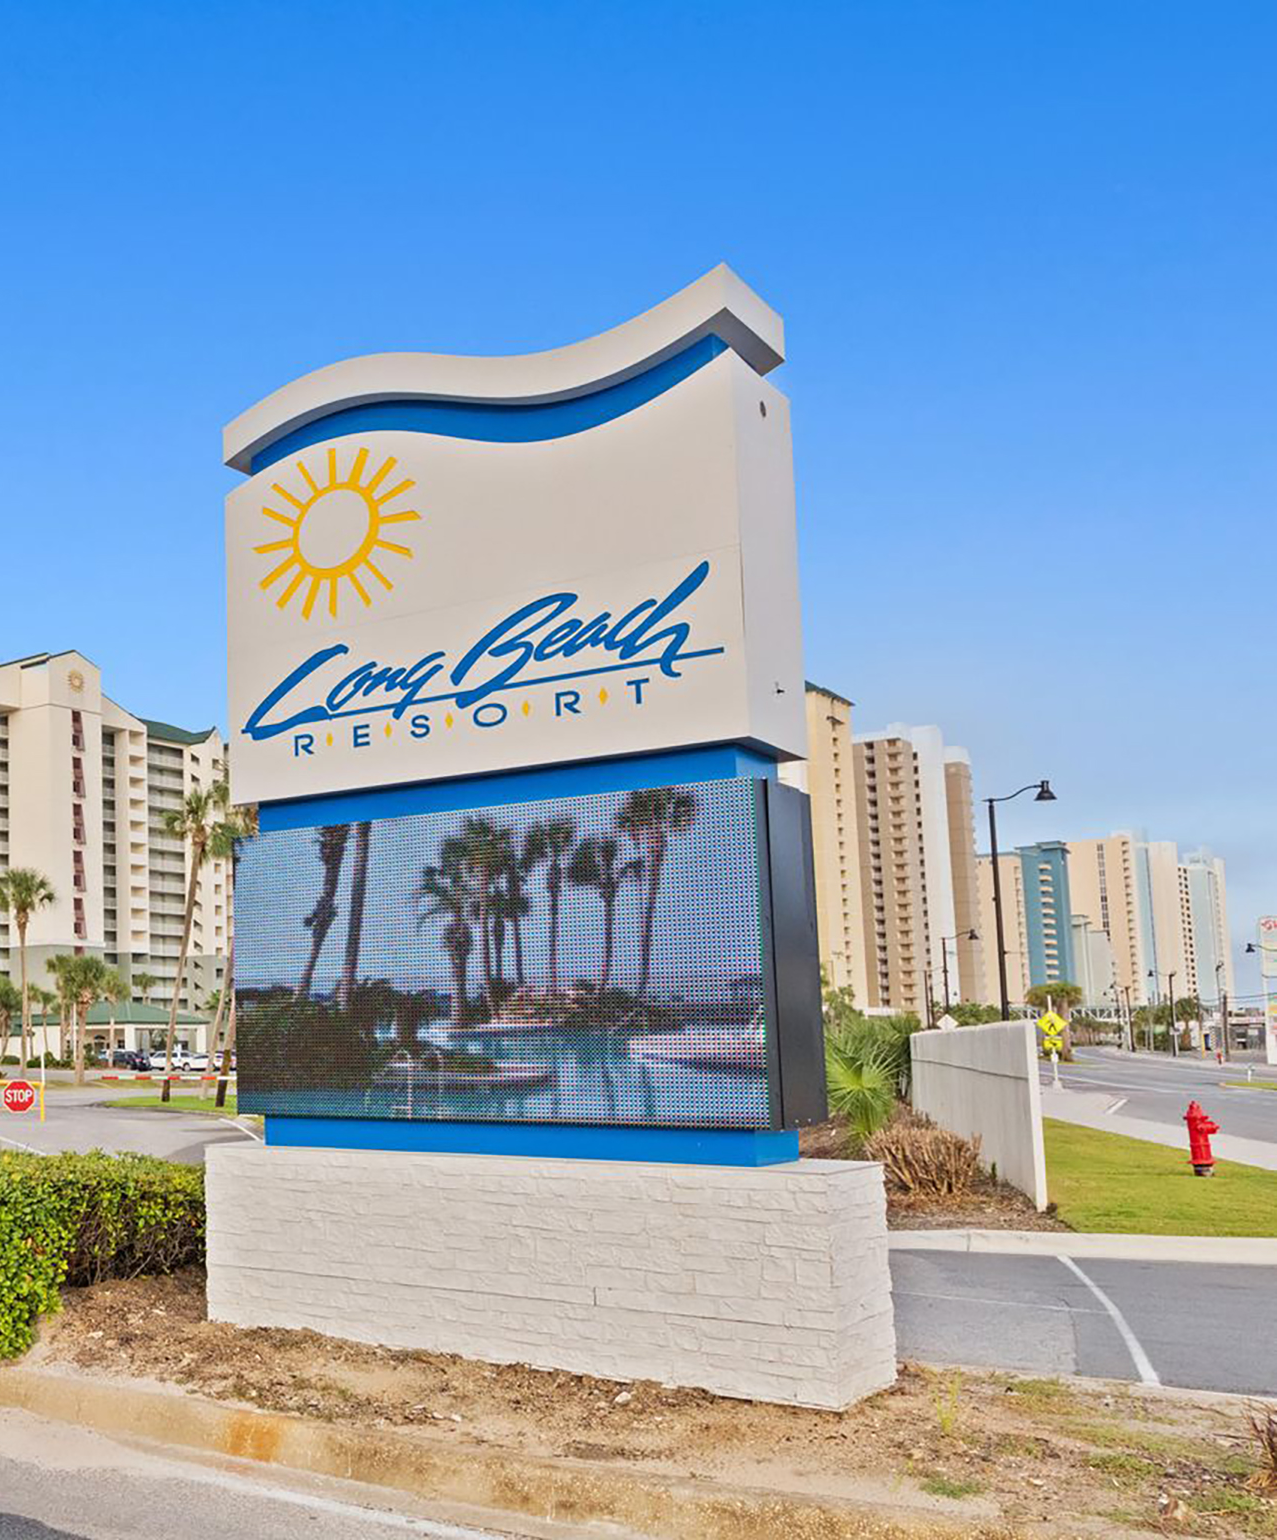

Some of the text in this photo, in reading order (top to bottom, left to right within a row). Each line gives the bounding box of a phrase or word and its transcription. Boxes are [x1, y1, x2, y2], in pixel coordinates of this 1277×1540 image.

[242, 560, 713, 740] Long Beach
[293, 677, 650, 758] RESORT
[5, 1089, 33, 1103] STOP
